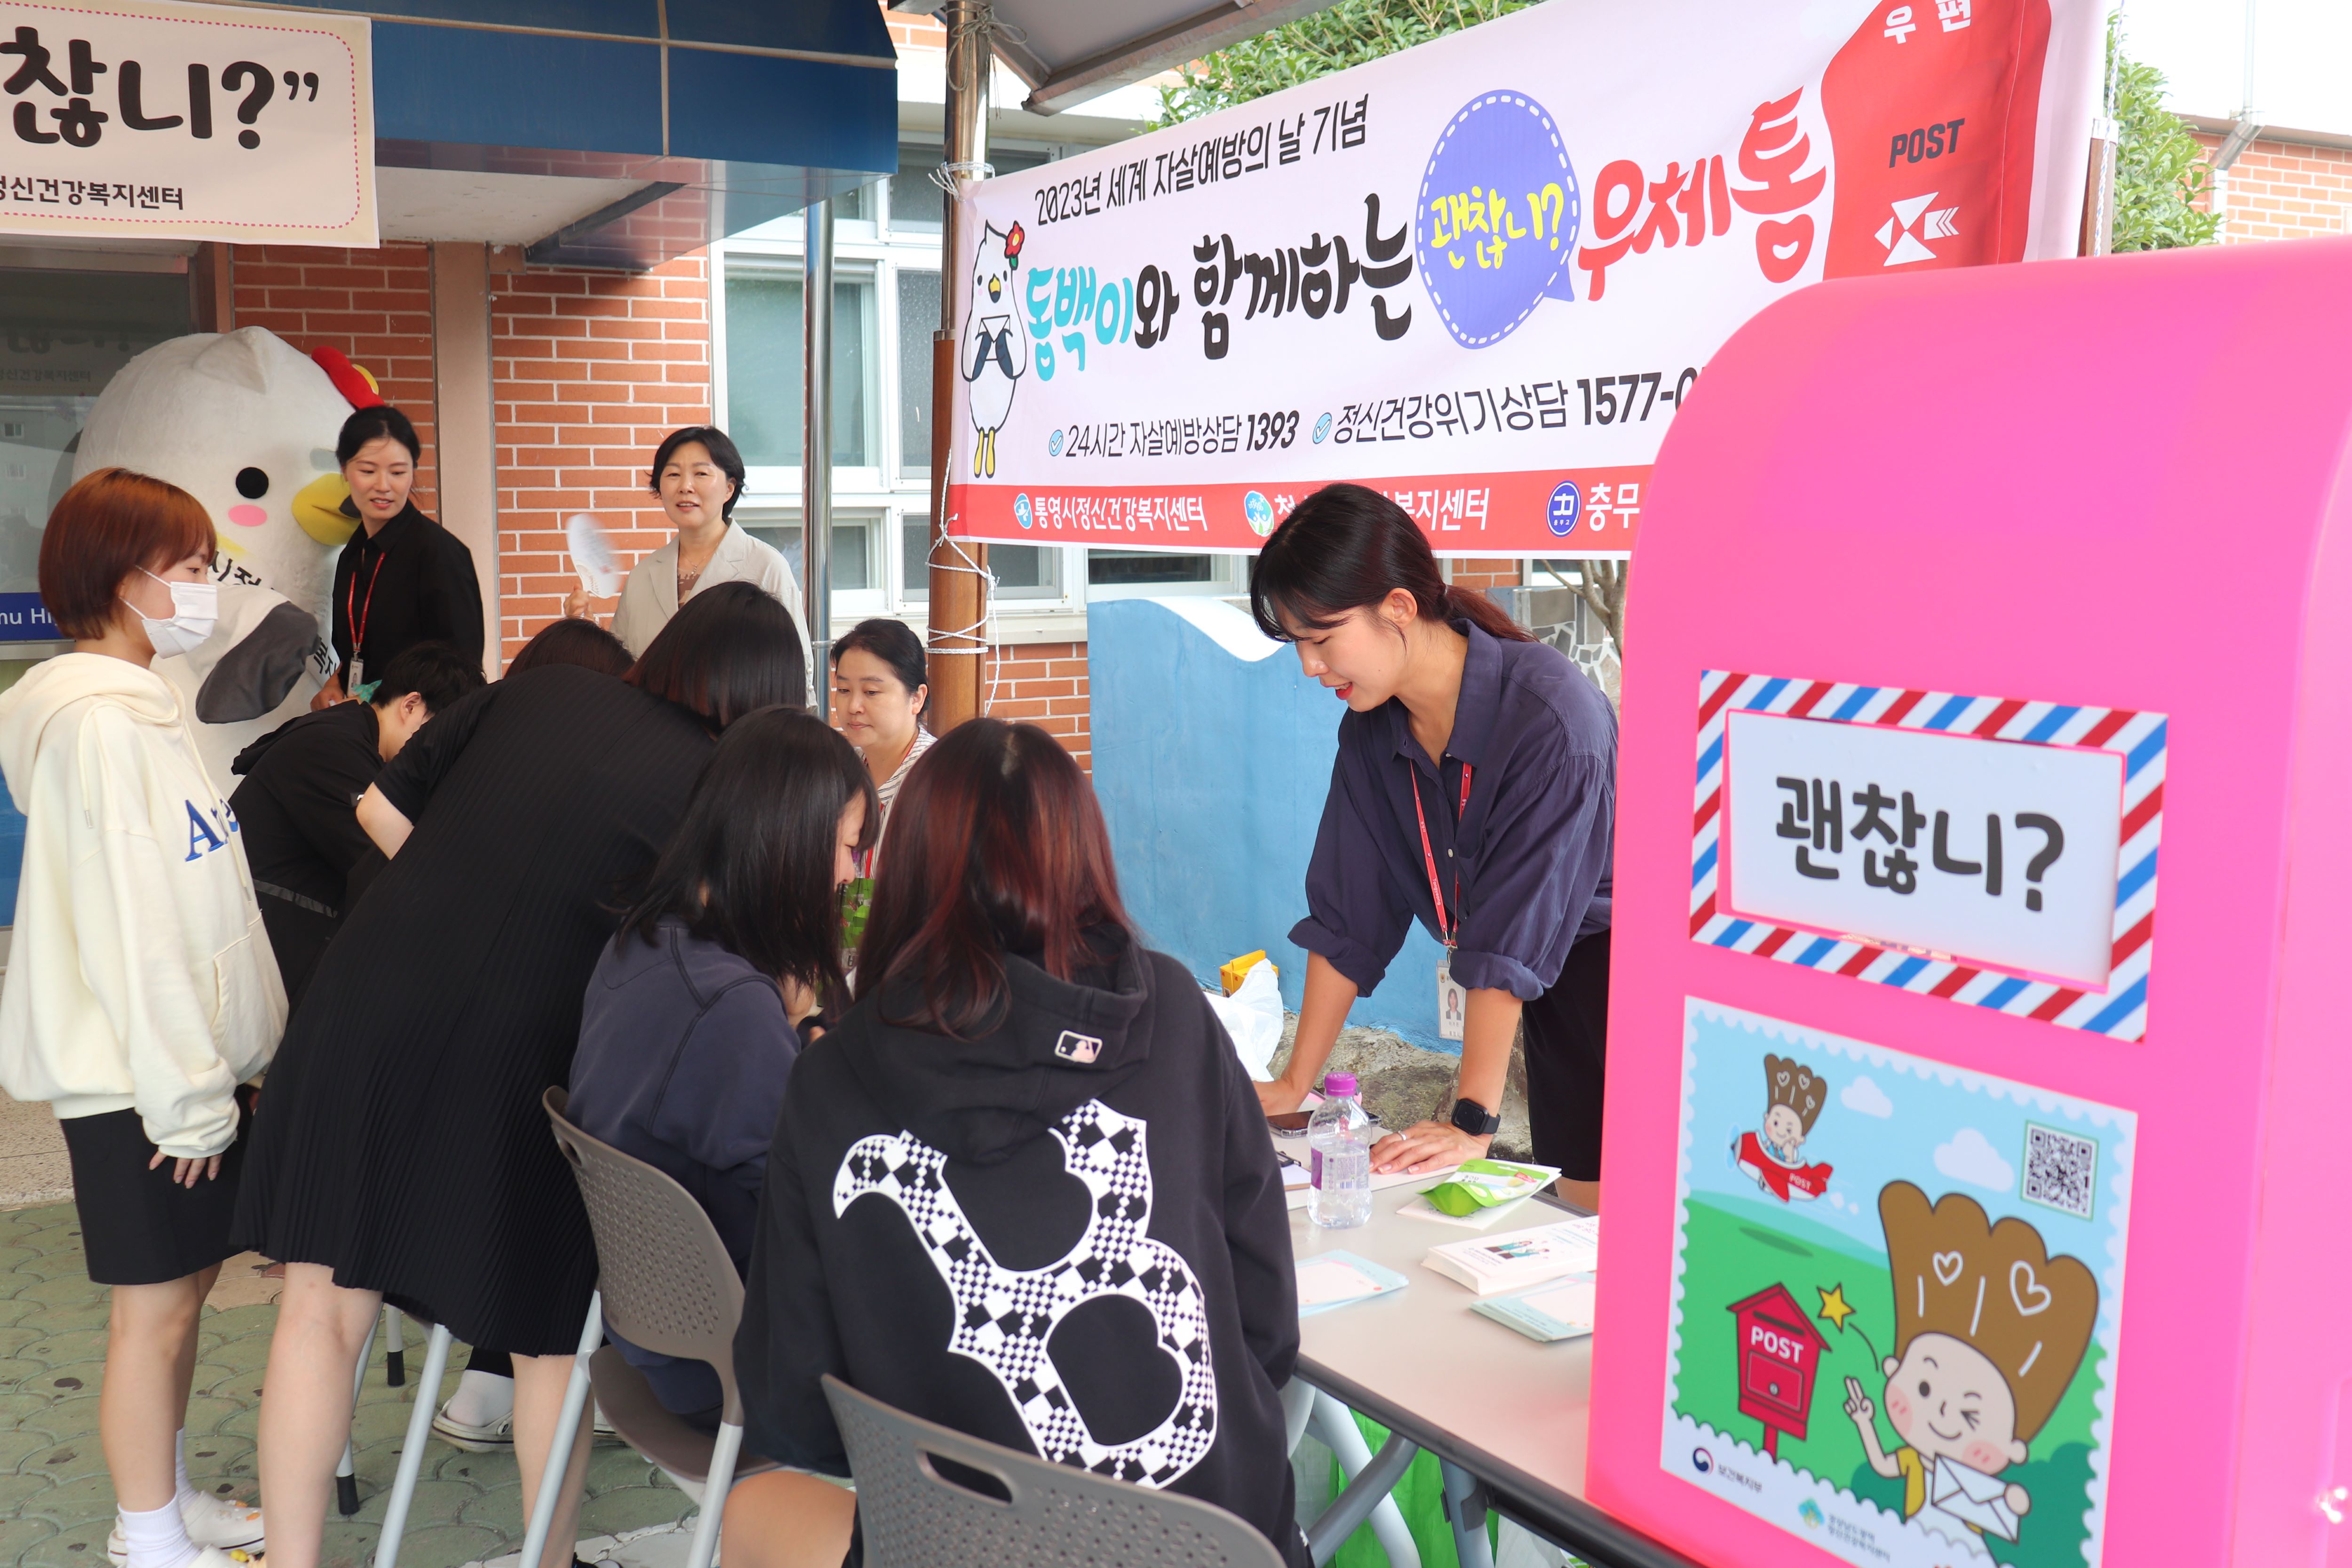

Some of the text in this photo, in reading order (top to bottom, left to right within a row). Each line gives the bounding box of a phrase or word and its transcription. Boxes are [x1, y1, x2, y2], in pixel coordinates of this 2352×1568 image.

[1035, 94, 1369, 226] 2023년 세계 자살예방의 날 기념
[1889, 118, 1965, 168] POST
[1026, 85, 1826, 381] 동백이와 함께하는 괜찮니? 우체통
[1334, 367, 1705, 444] 정신건강위기상담 1577-0
[1065, 410, 1300, 457] 24시간 자살예방상담 1393
[1034, 494, 1208, 532] 통영시정신건강복지센터
[1776, 777, 2065, 913] 괜찮니?
[1432, 878, 1441, 906] Tongyeong
[1789, 1172, 1812, 1191] POST
[1750, 1325, 1804, 1364] POST
